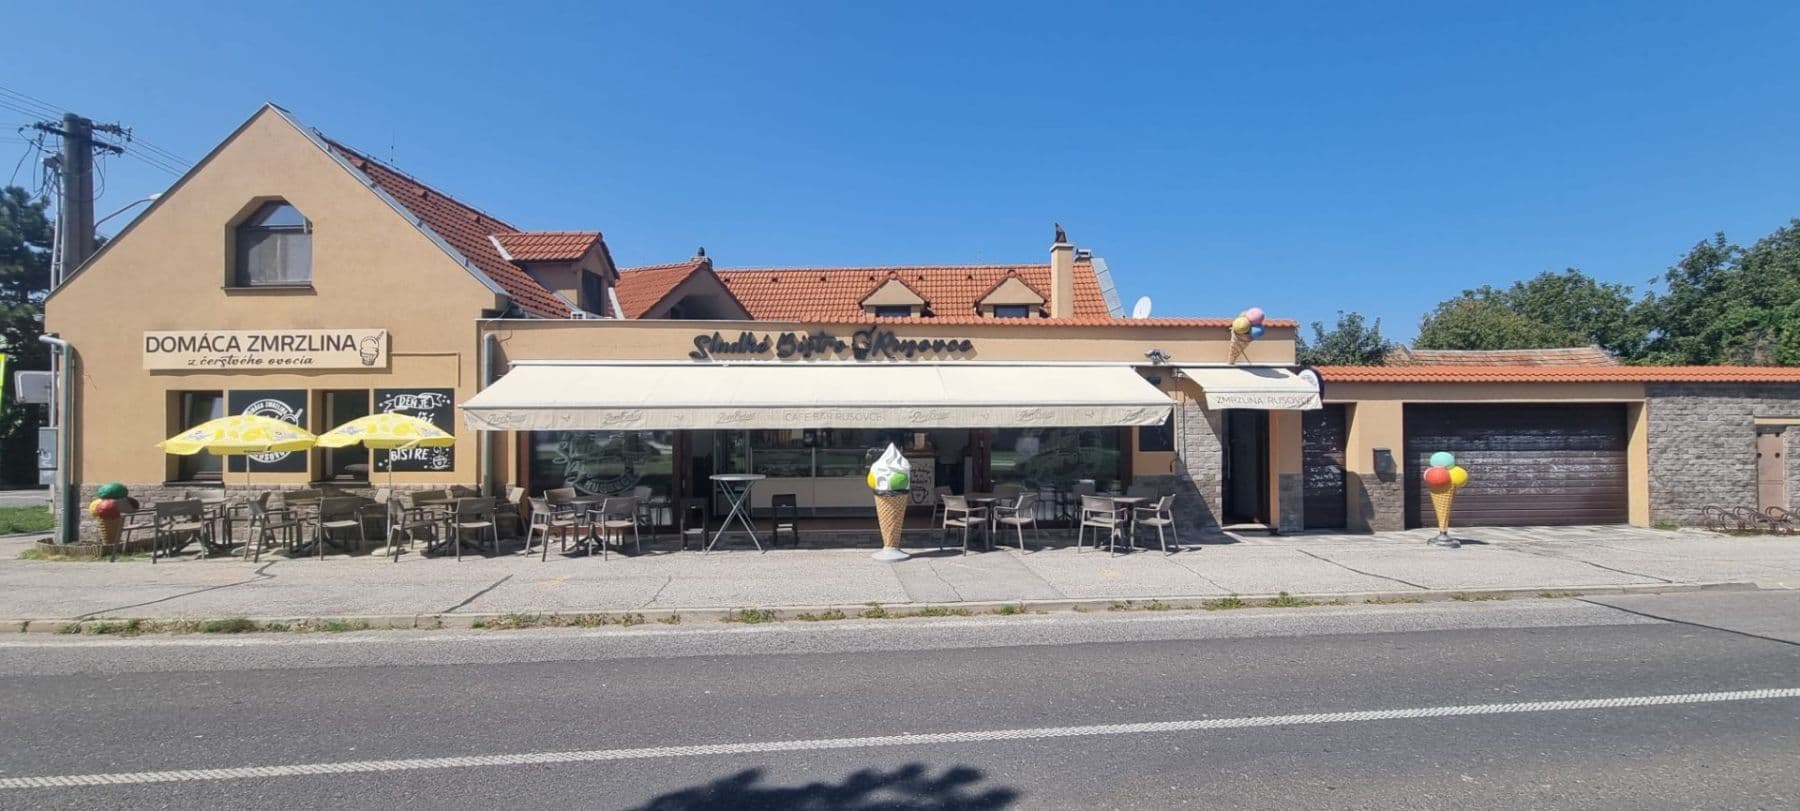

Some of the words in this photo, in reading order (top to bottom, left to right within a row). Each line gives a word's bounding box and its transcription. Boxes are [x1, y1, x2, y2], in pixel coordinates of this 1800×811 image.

[145, 333, 242, 353] DOMÁCA
[246, 334, 358, 352] ZMRZLINA
[199, 354, 265, 368] čerstvého
[267, 355, 314, 366] ovocia
[390, 448, 430, 461] BISTRE
